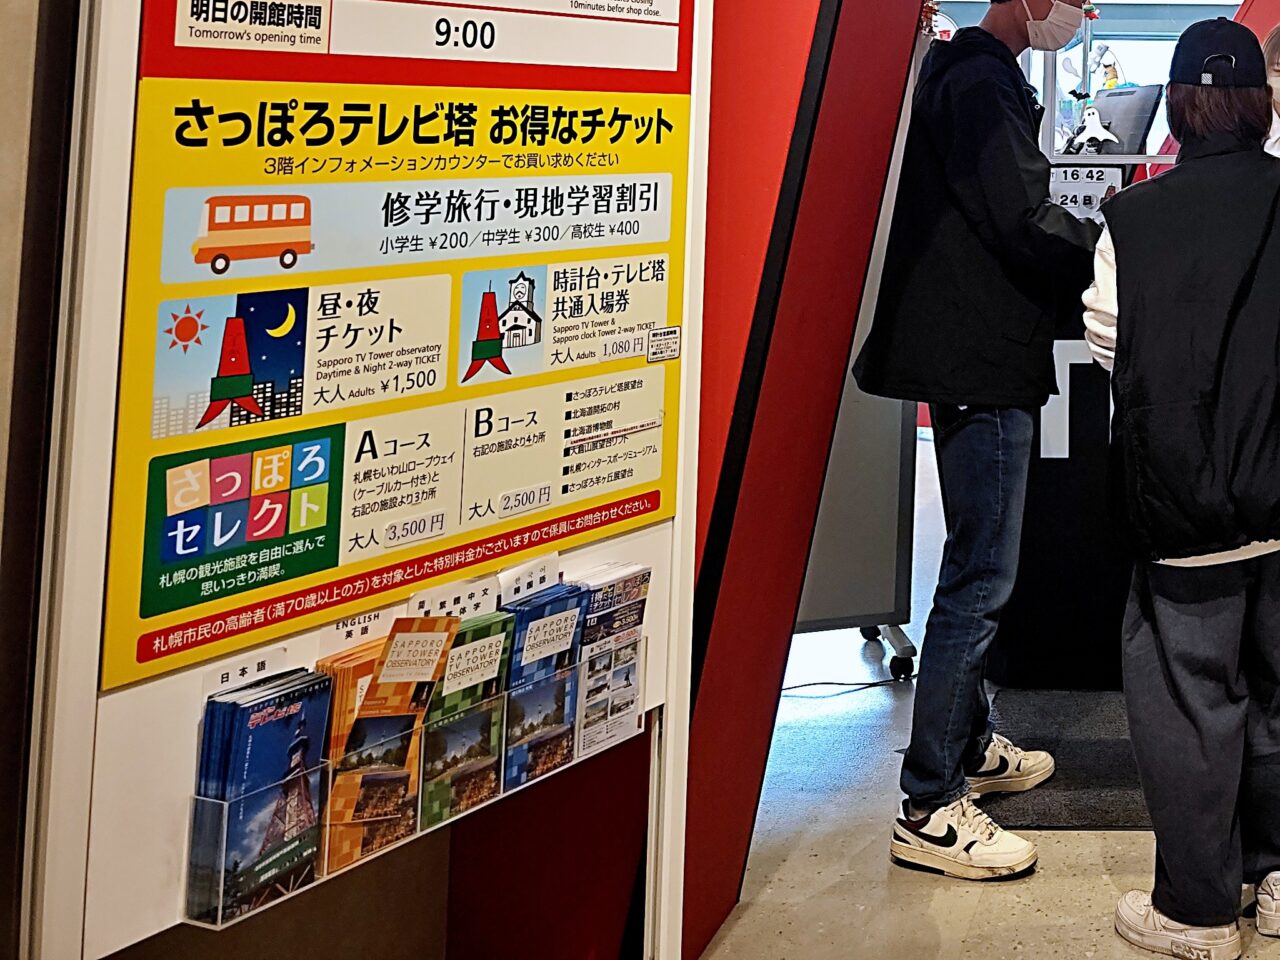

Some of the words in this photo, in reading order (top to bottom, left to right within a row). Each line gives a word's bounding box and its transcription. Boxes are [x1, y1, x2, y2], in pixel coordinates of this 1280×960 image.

[188, 26, 251, 41] Tomorrow's
[255, 32, 295, 46] opening
[299, 33, 321, 45] time
[435, 18, 495, 49] 9:00
[174, 98, 477, 147] さっぽろテレビ塔
[489, 104, 674, 147] お得なチケット
[264, 152, 619, 176] 3階インフォメーションカウンターでお買い求めください
[381, 181, 659, 228] 修学旅行・現地学習割引
[553, 259, 665, 292] 時計台・テレビ塔
[317, 289, 380, 321] 昼・夜
[552, 289, 630, 321] 共通入場券
[316, 319, 402, 353] チケット
[552, 323, 580, 334] Sapporo
[580, 321, 589, 330] TV
[590, 319, 609, 328] Tower
[552, 333, 579, 345] Sapporo
[580, 330, 596, 339] clock
[597, 329, 616, 337] Tower
[617, 326, 635, 335] 2-way
[636, 322, 655, 331] TICKET
[316, 367, 352, 381] Daytime
[362, 362, 386, 375] Night
[389, 358, 412, 372] 2-way
[414, 353, 441, 365] TICKET
[317, 355, 353, 370] Sapporo
[355, 353, 367, 364] TV
[368, 349, 393, 362] Tower
[396, 343, 442, 360] observatory
[551, 348, 574, 366] 大人
[575, 350, 596, 360] Adults
[313, 384, 345, 406] 大人
[348, 386, 375, 400] Adults
[380, 369, 436, 395] ¥1,500
[174, 445, 325, 508] さっぽろ
[469, 499, 495, 520] 大人
[168, 493, 320, 555] セレクト
[349, 529, 379, 552] 大人
[159, 535, 326, 589] 札幌の観光施設を自由に選んで
[335, 613, 381, 631] ENGLISH
[345, 626, 369, 640] 英語
[529, 615, 576, 635] SAPPORO
[392, 640, 443, 648] SAPPORO
[450, 641, 501, 663] SAPPORO
[220, 660, 267, 685] 日本語
